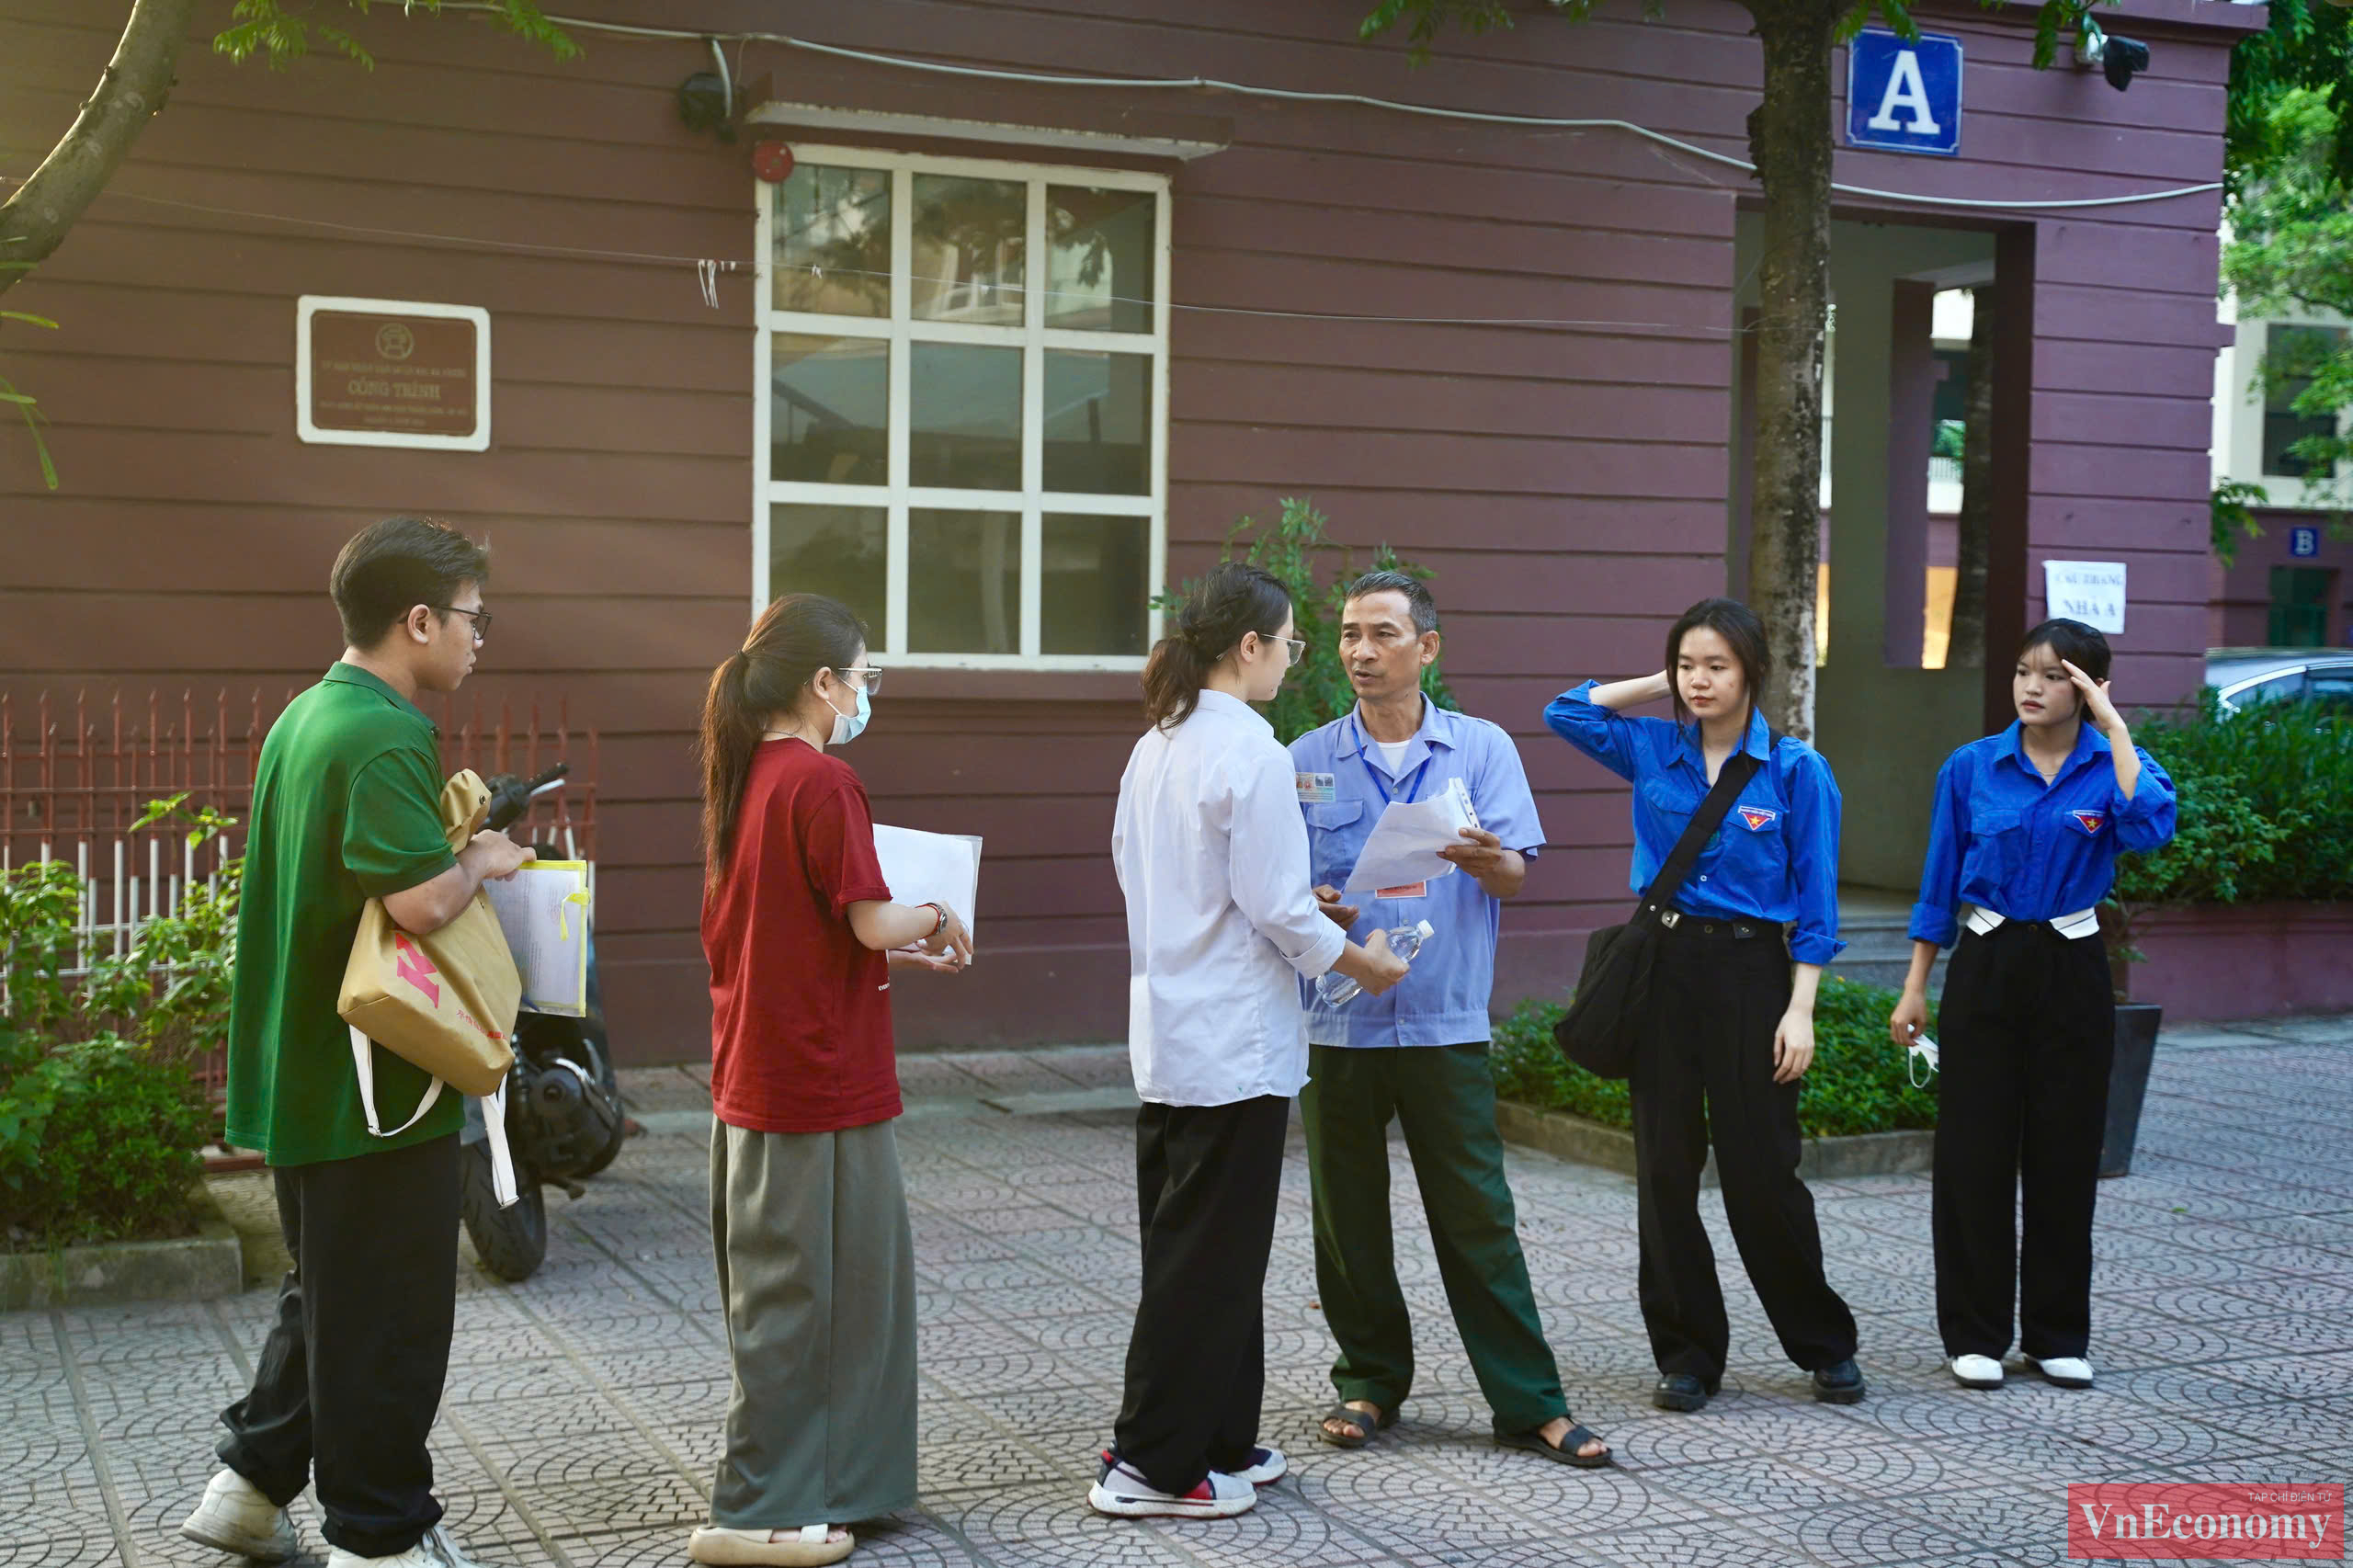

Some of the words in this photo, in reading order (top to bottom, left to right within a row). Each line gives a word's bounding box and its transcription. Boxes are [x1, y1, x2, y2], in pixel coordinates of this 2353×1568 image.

[1868, 50, 1941, 135] A
[2294, 529, 2314, 555] B
[2105, 603, 2117, 618] A
